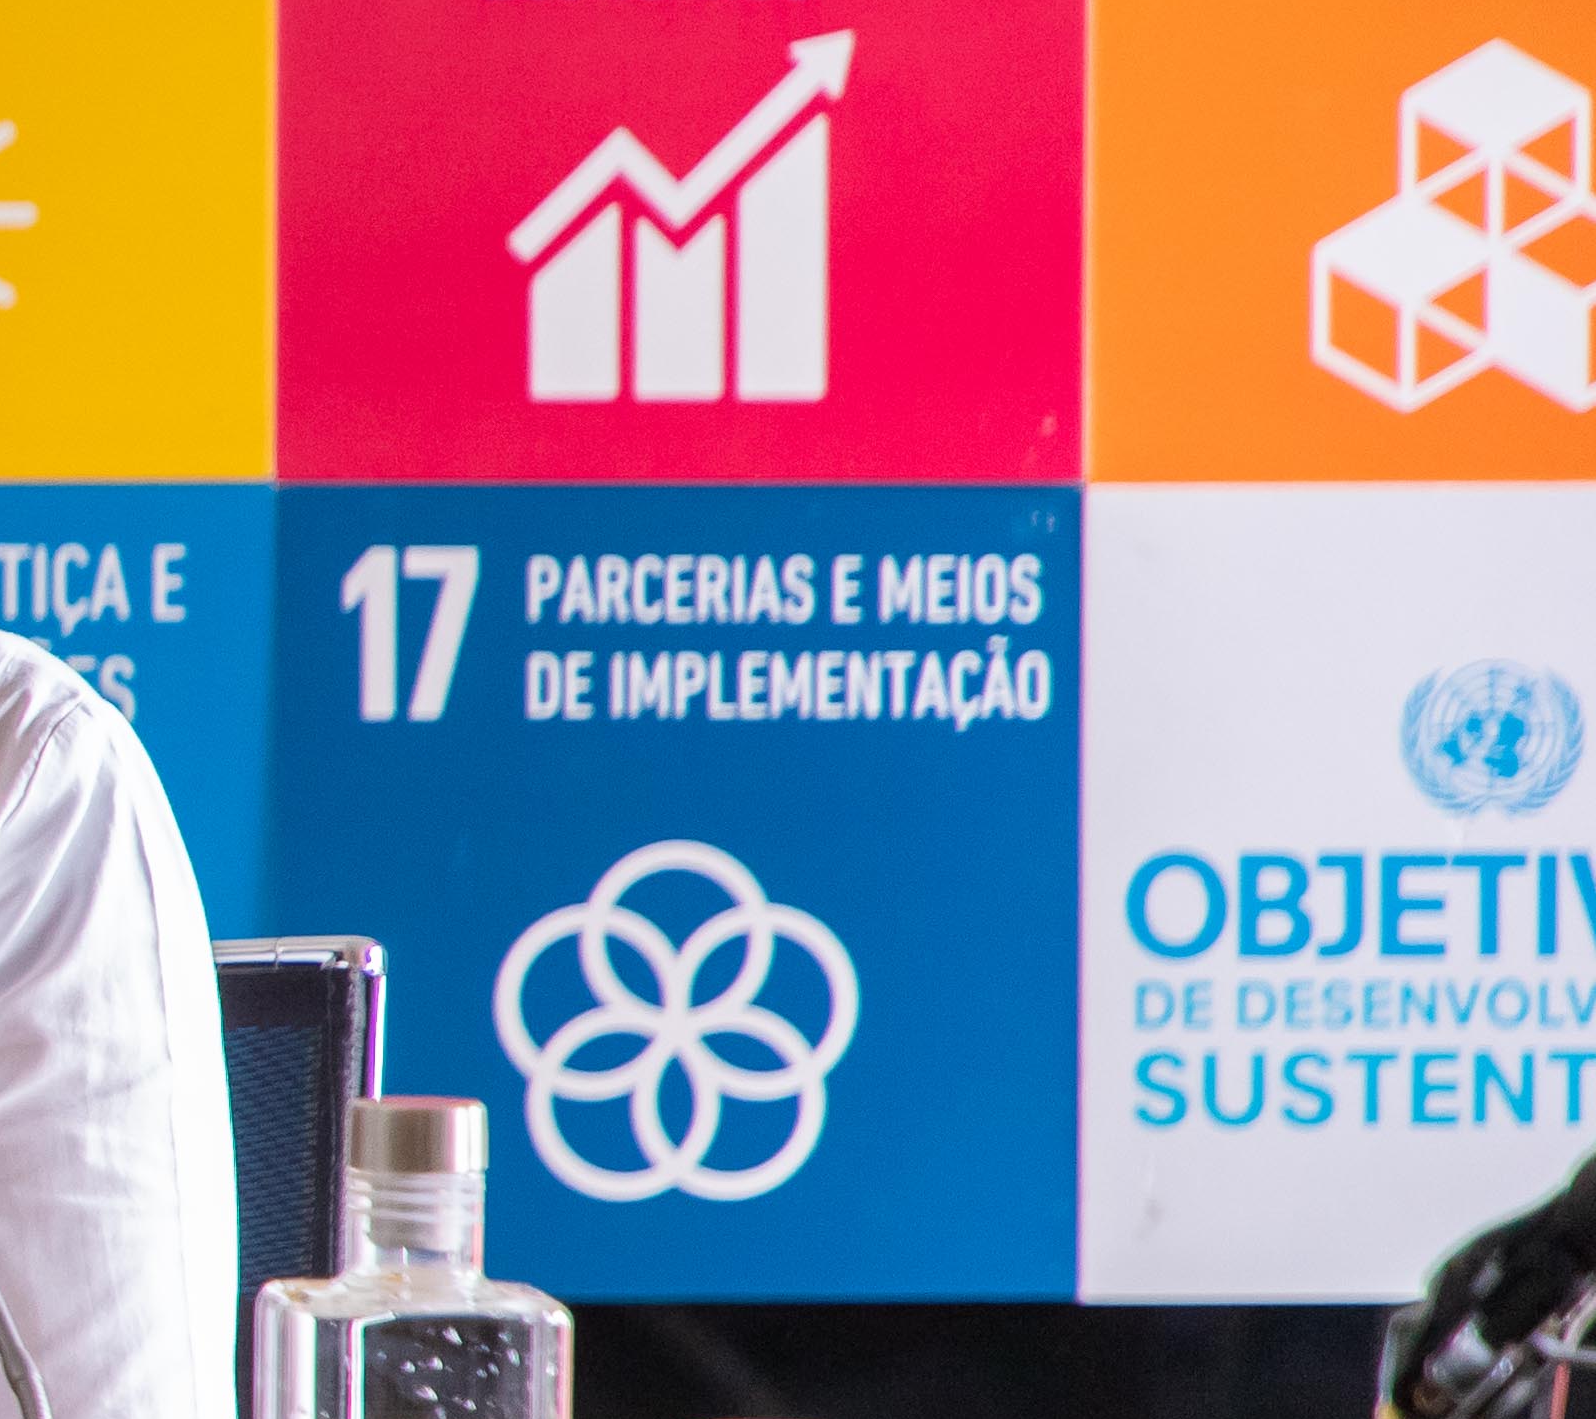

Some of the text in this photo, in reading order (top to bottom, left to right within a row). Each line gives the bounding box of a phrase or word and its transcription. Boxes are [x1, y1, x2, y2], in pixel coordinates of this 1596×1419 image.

[150, 542, 187, 623] E
[527, 554, 1042, 624] PARCERIAS E MEIOS
[341, 546, 479, 721] 17
[526, 635, 1051, 731] DE IMPLEMENTAÇÃO
[1134, 980, 1212, 1029] DE
